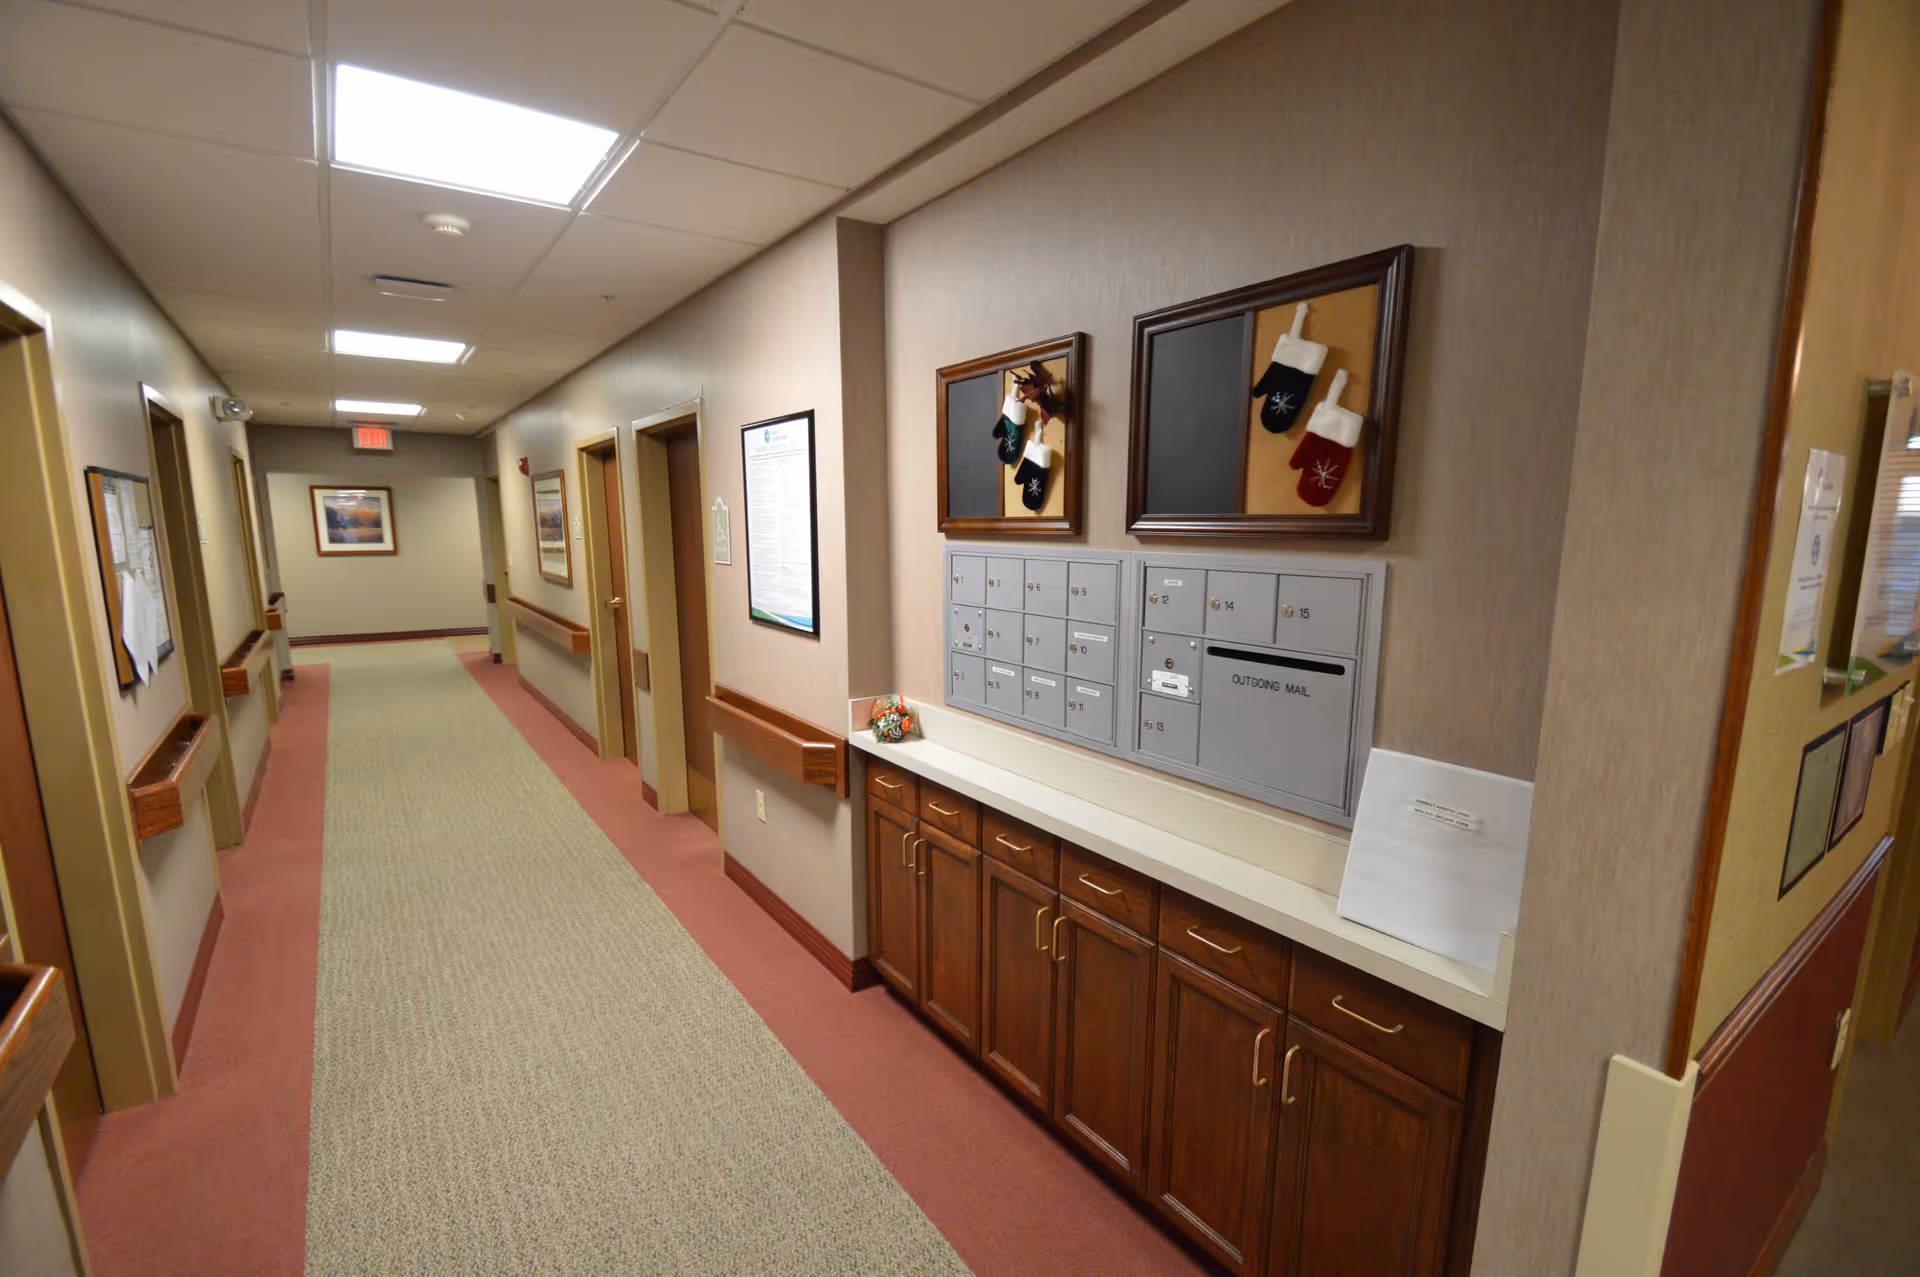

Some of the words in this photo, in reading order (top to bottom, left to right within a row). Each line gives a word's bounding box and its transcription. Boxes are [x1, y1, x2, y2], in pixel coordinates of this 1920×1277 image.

[1036, 583, 1041, 592] 6
[1081, 587, 1087, 596] 9
[1161, 594, 1170, 605] 12
[1224, 601, 1234, 611] 14
[1299, 608, 1310, 619] 15
[996, 631, 1001, 639] 4
[1080, 646, 1087, 655] 10
[996, 681, 1001, 689] 5
[1232, 674, 1281, 692] OUTGOING
[1285, 683, 1311, 698] MAIL
[1035, 691, 1040, 700] 8
[1079, 702, 1084, 711] 11
[1156, 722, 1165, 732] 13
